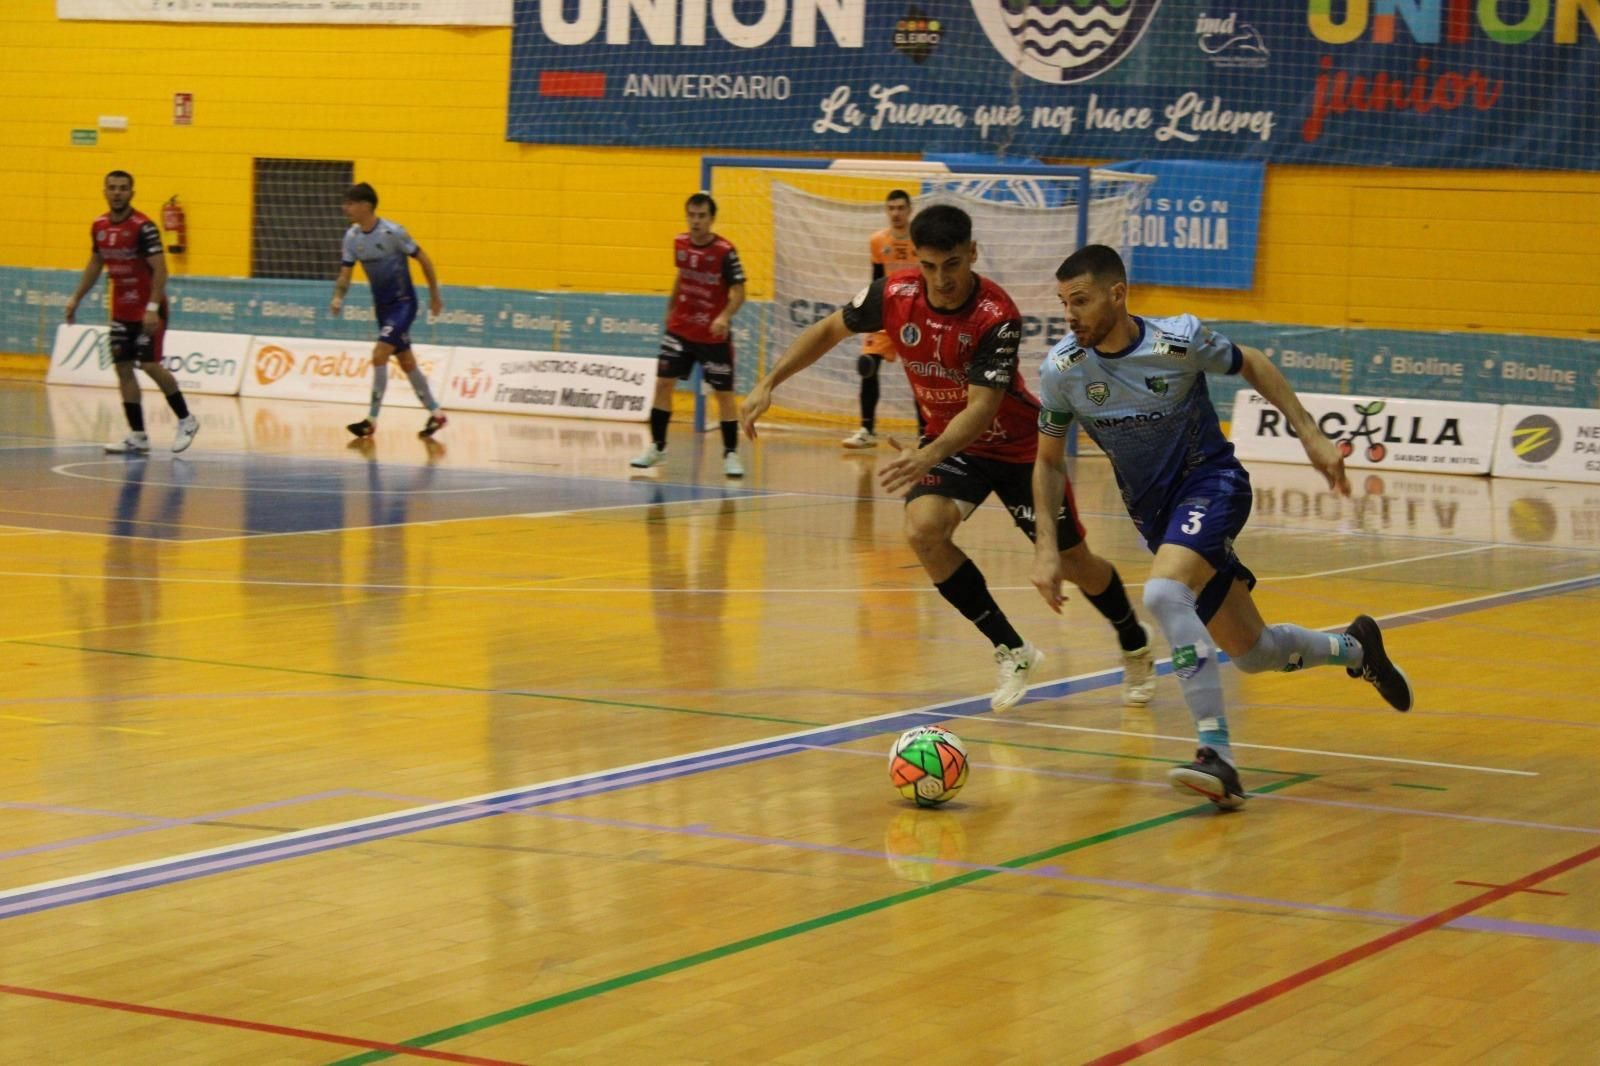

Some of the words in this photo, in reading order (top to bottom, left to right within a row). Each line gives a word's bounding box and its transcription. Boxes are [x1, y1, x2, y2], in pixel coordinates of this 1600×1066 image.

[540, 0, 866, 48] UNION
[622, 73, 791, 100] ANIVERSARIO
[1302, 55, 1503, 143] junior
[813, 85, 864, 134] La
[869, 83, 968, 131] Fuerza
[974, 104, 1025, 139] que
[1085, 93, 1152, 132] hace
[1173, 215, 1229, 250] SALA
[512, 312, 573, 333] Bioline
[601, 317, 661, 336] Bioline
[1281, 350, 1354, 372] Bioline
[1391, 356, 1465, 377] Bioline
[1502, 360, 1577, 384] Bioline
[495, 383, 556, 405] Francisco
[561, 387, 602, 409] Muñoz
[1180, 510, 1206, 536] 3
